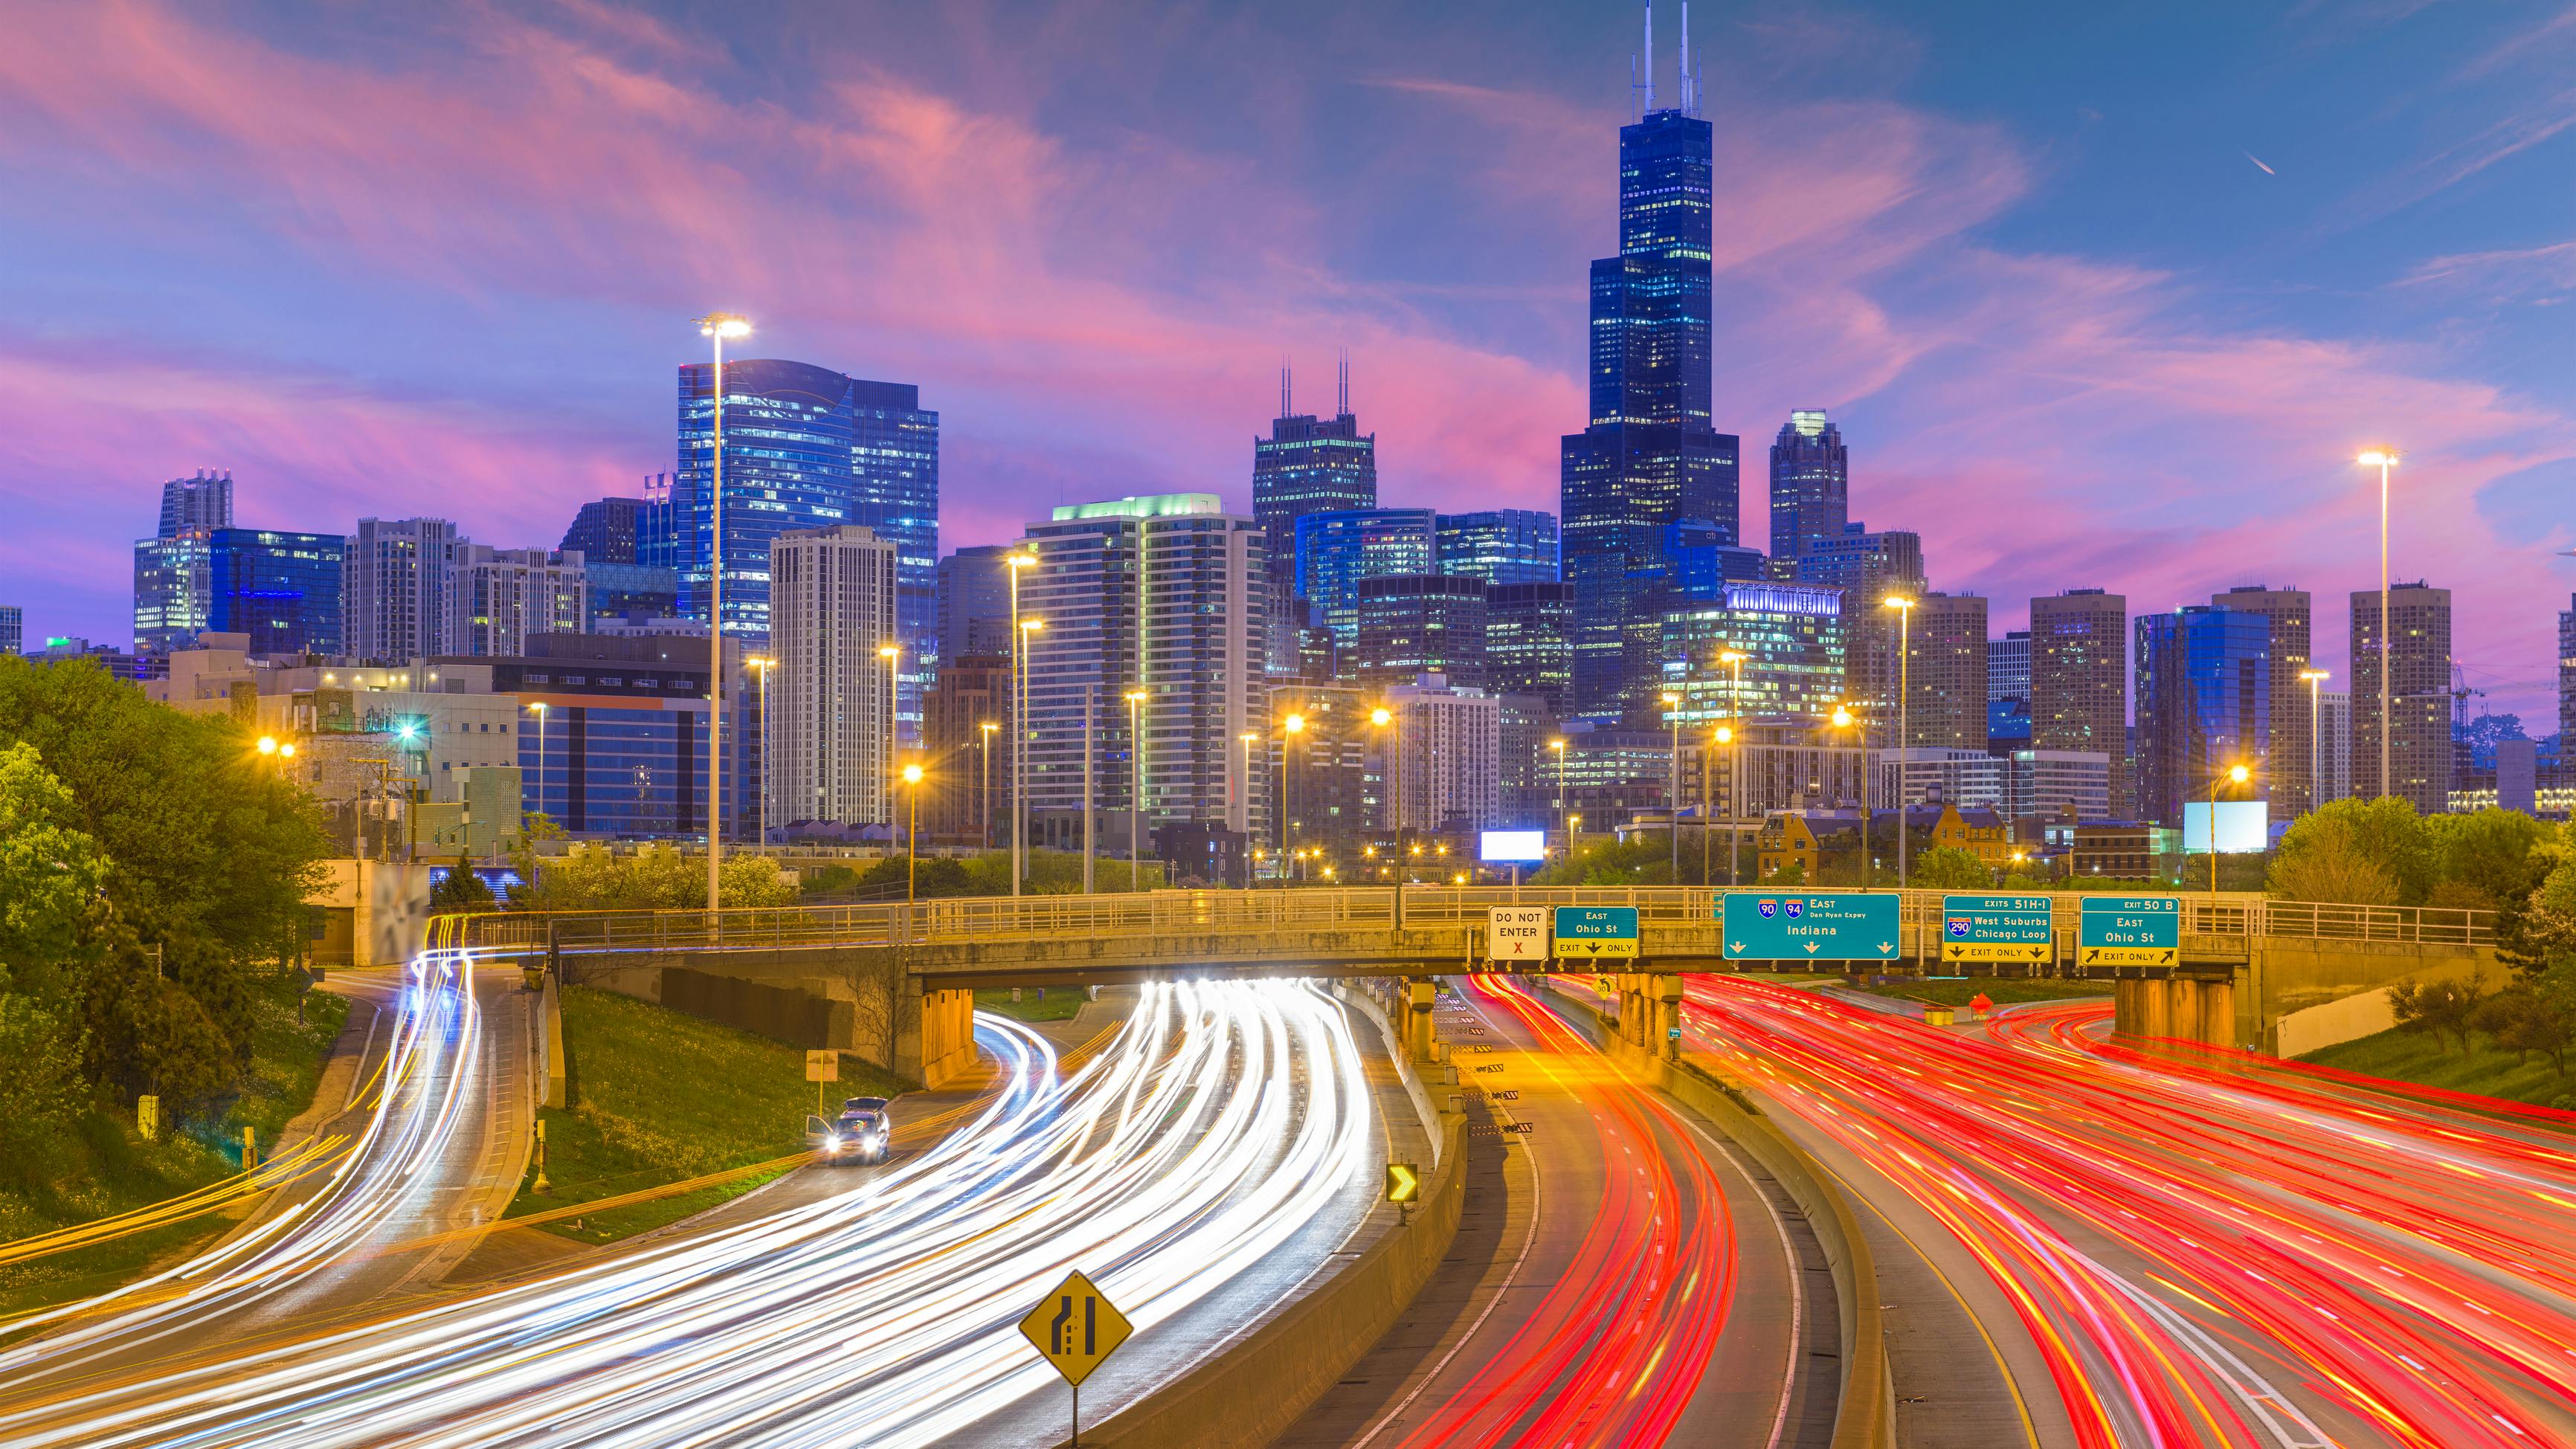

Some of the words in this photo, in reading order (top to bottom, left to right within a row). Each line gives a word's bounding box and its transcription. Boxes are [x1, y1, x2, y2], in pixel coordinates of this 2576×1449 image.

[1810, 899, 1835, 909] EAST
[2144, 901, 2160, 910] 50
[2166, 901, 2173, 909] B
[1761, 905, 1774, 914] 90
[1787, 905, 1800, 914] 94
[1496, 913, 1511, 923] DO
[1519, 913, 1542, 923] NOT
[1585, 911, 1608, 920] EAST
[1975, 917, 1998, 926] West
[2004, 917, 2047, 926] Suburbs
[2116, 917, 2143, 927] EAST
[1500, 927, 1537, 937] ENTER
[1576, 924, 1600, 933] Ohio
[1606, 924, 1617, 933] St
[1787, 925, 1837, 935] Indiana
[1951, 923, 1968, 932] 290
[1975, 929, 2018, 940] Chicago
[2022, 930, 2047, 940] Loop
[2105, 932, 2134, 943] Ohio
[2141, 932, 2154, 943] St
[1513, 942, 1523, 954] X
[1607, 944, 1633, 952] ONLY
[1997, 949, 2023, 957] ONLY
[2104, 952, 2125, 961] EXIT
